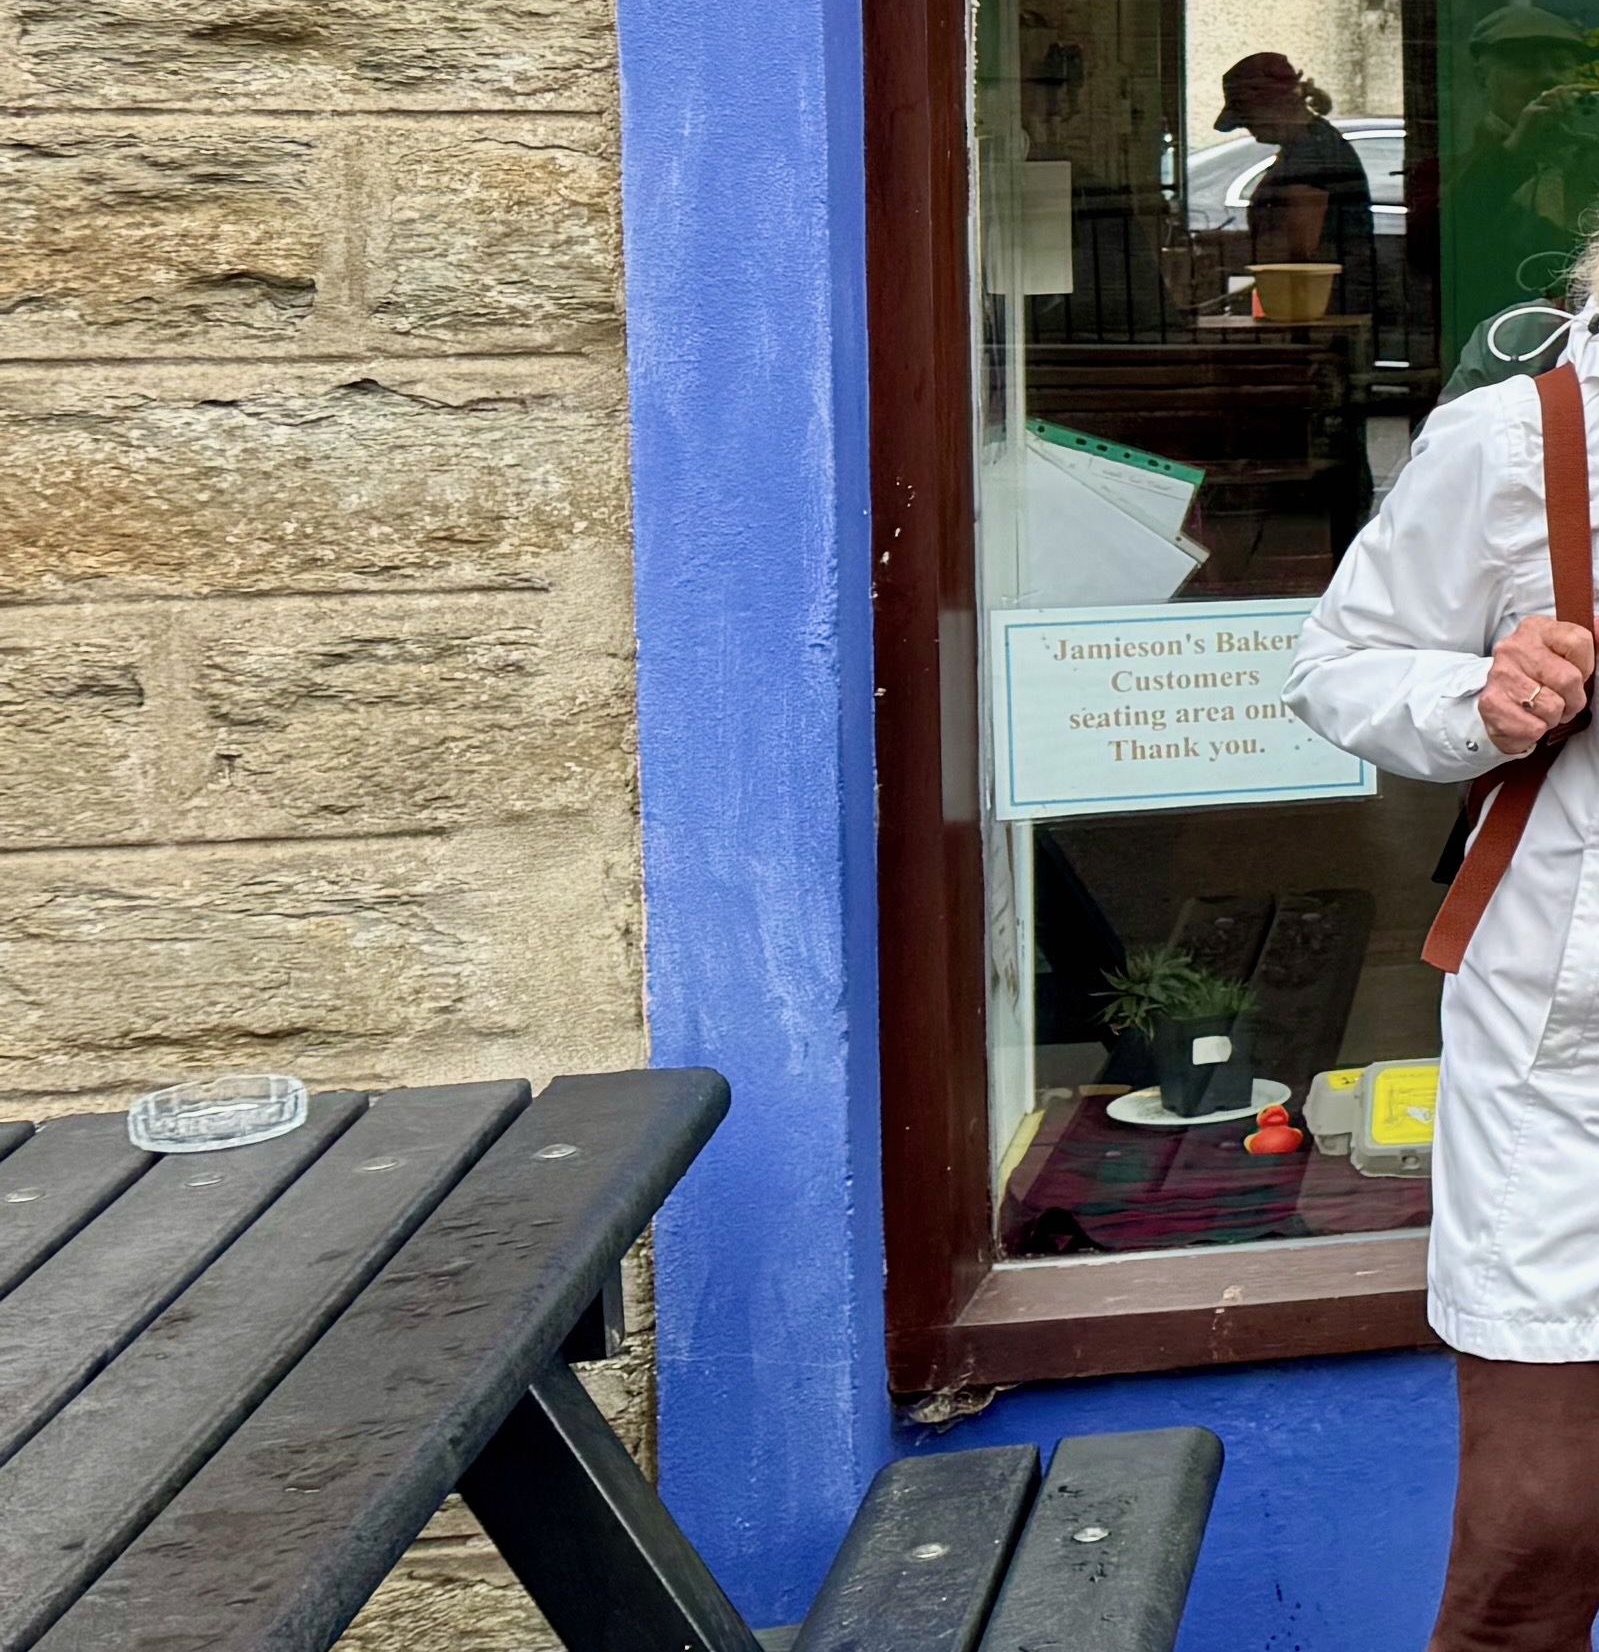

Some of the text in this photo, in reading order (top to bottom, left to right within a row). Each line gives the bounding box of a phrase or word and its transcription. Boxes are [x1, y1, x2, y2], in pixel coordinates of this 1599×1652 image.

[1053, 629, 1298, 663] Jamieson's Baker
[1110, 669, 1260, 694] Customers
[1069, 705, 1167, 730] seating
[1175, 706, 1236, 724] area
[1107, 738, 1267, 762] Thank you.
